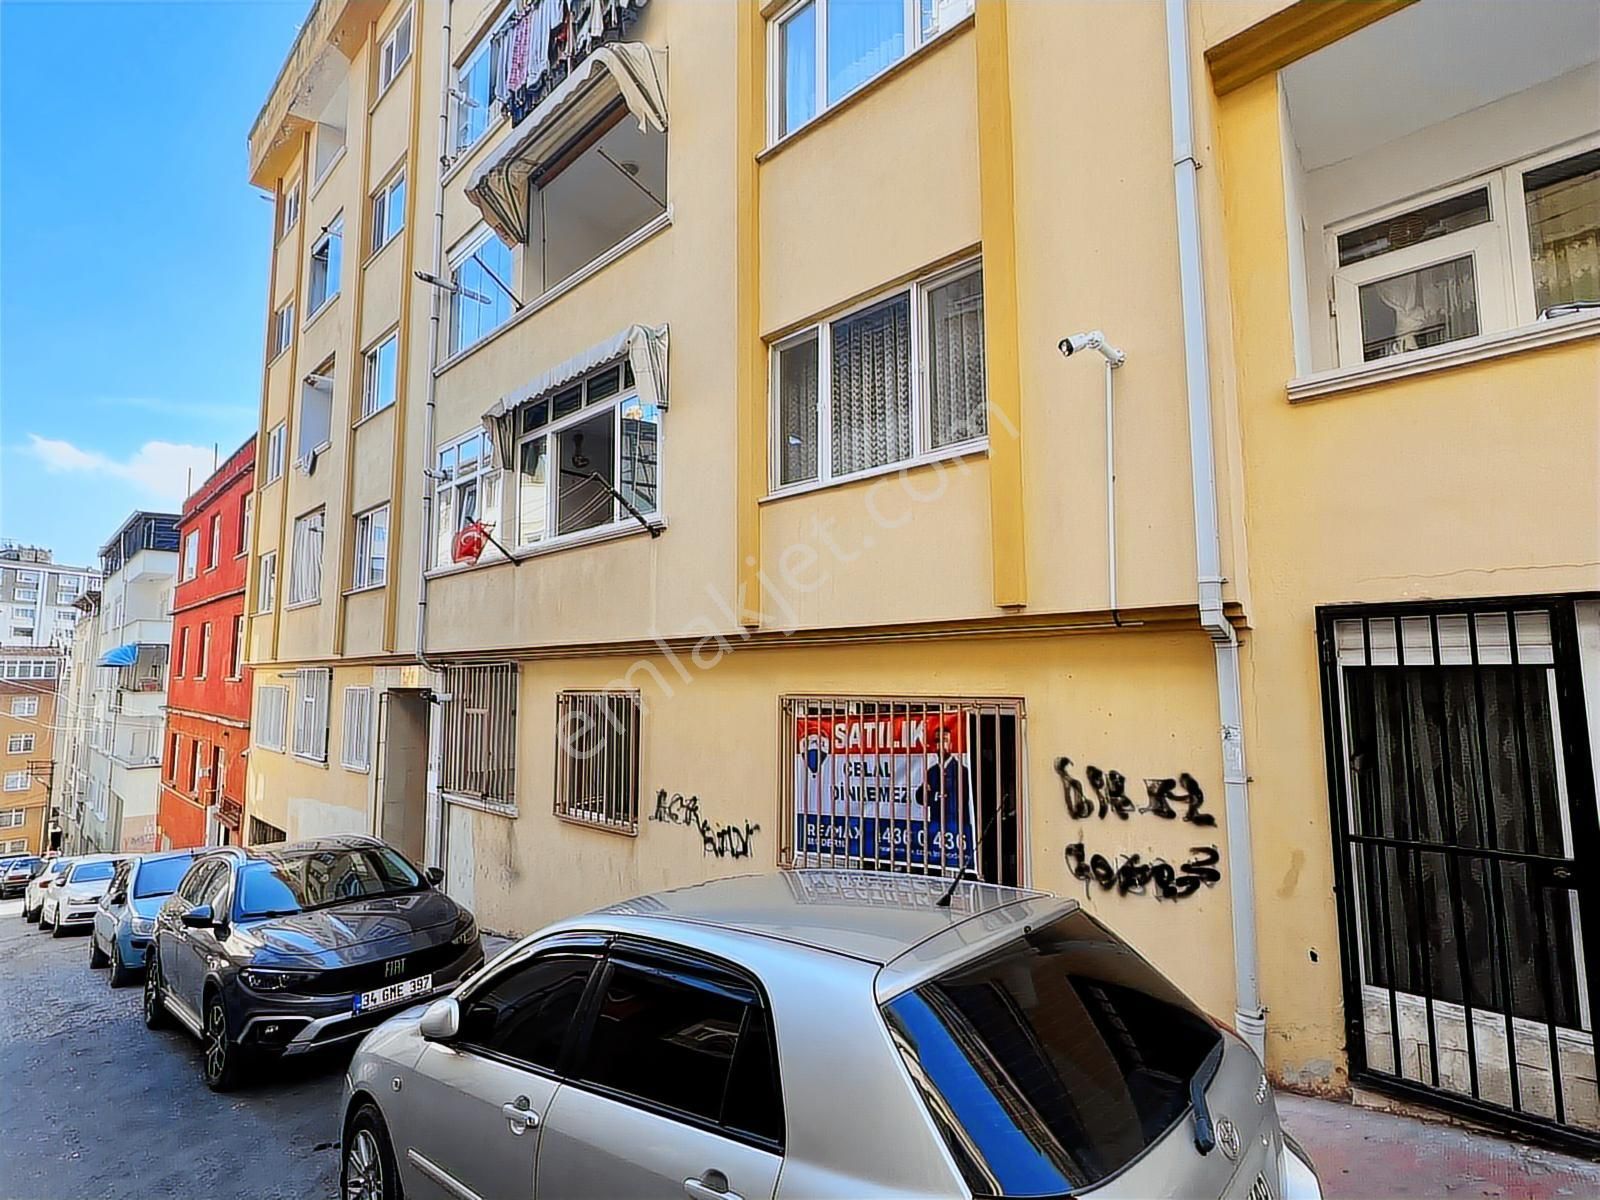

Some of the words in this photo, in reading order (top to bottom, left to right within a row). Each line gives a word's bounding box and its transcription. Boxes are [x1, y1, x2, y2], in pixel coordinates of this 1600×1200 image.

[835, 719, 927, 749] SATILIK
[843, 761, 892, 778] CELAL
[385, 958, 407, 978] FIAT
[362, 992, 378, 1007] 34
[382, 983, 405, 1002] GME
[409, 976, 430, 993] 397
